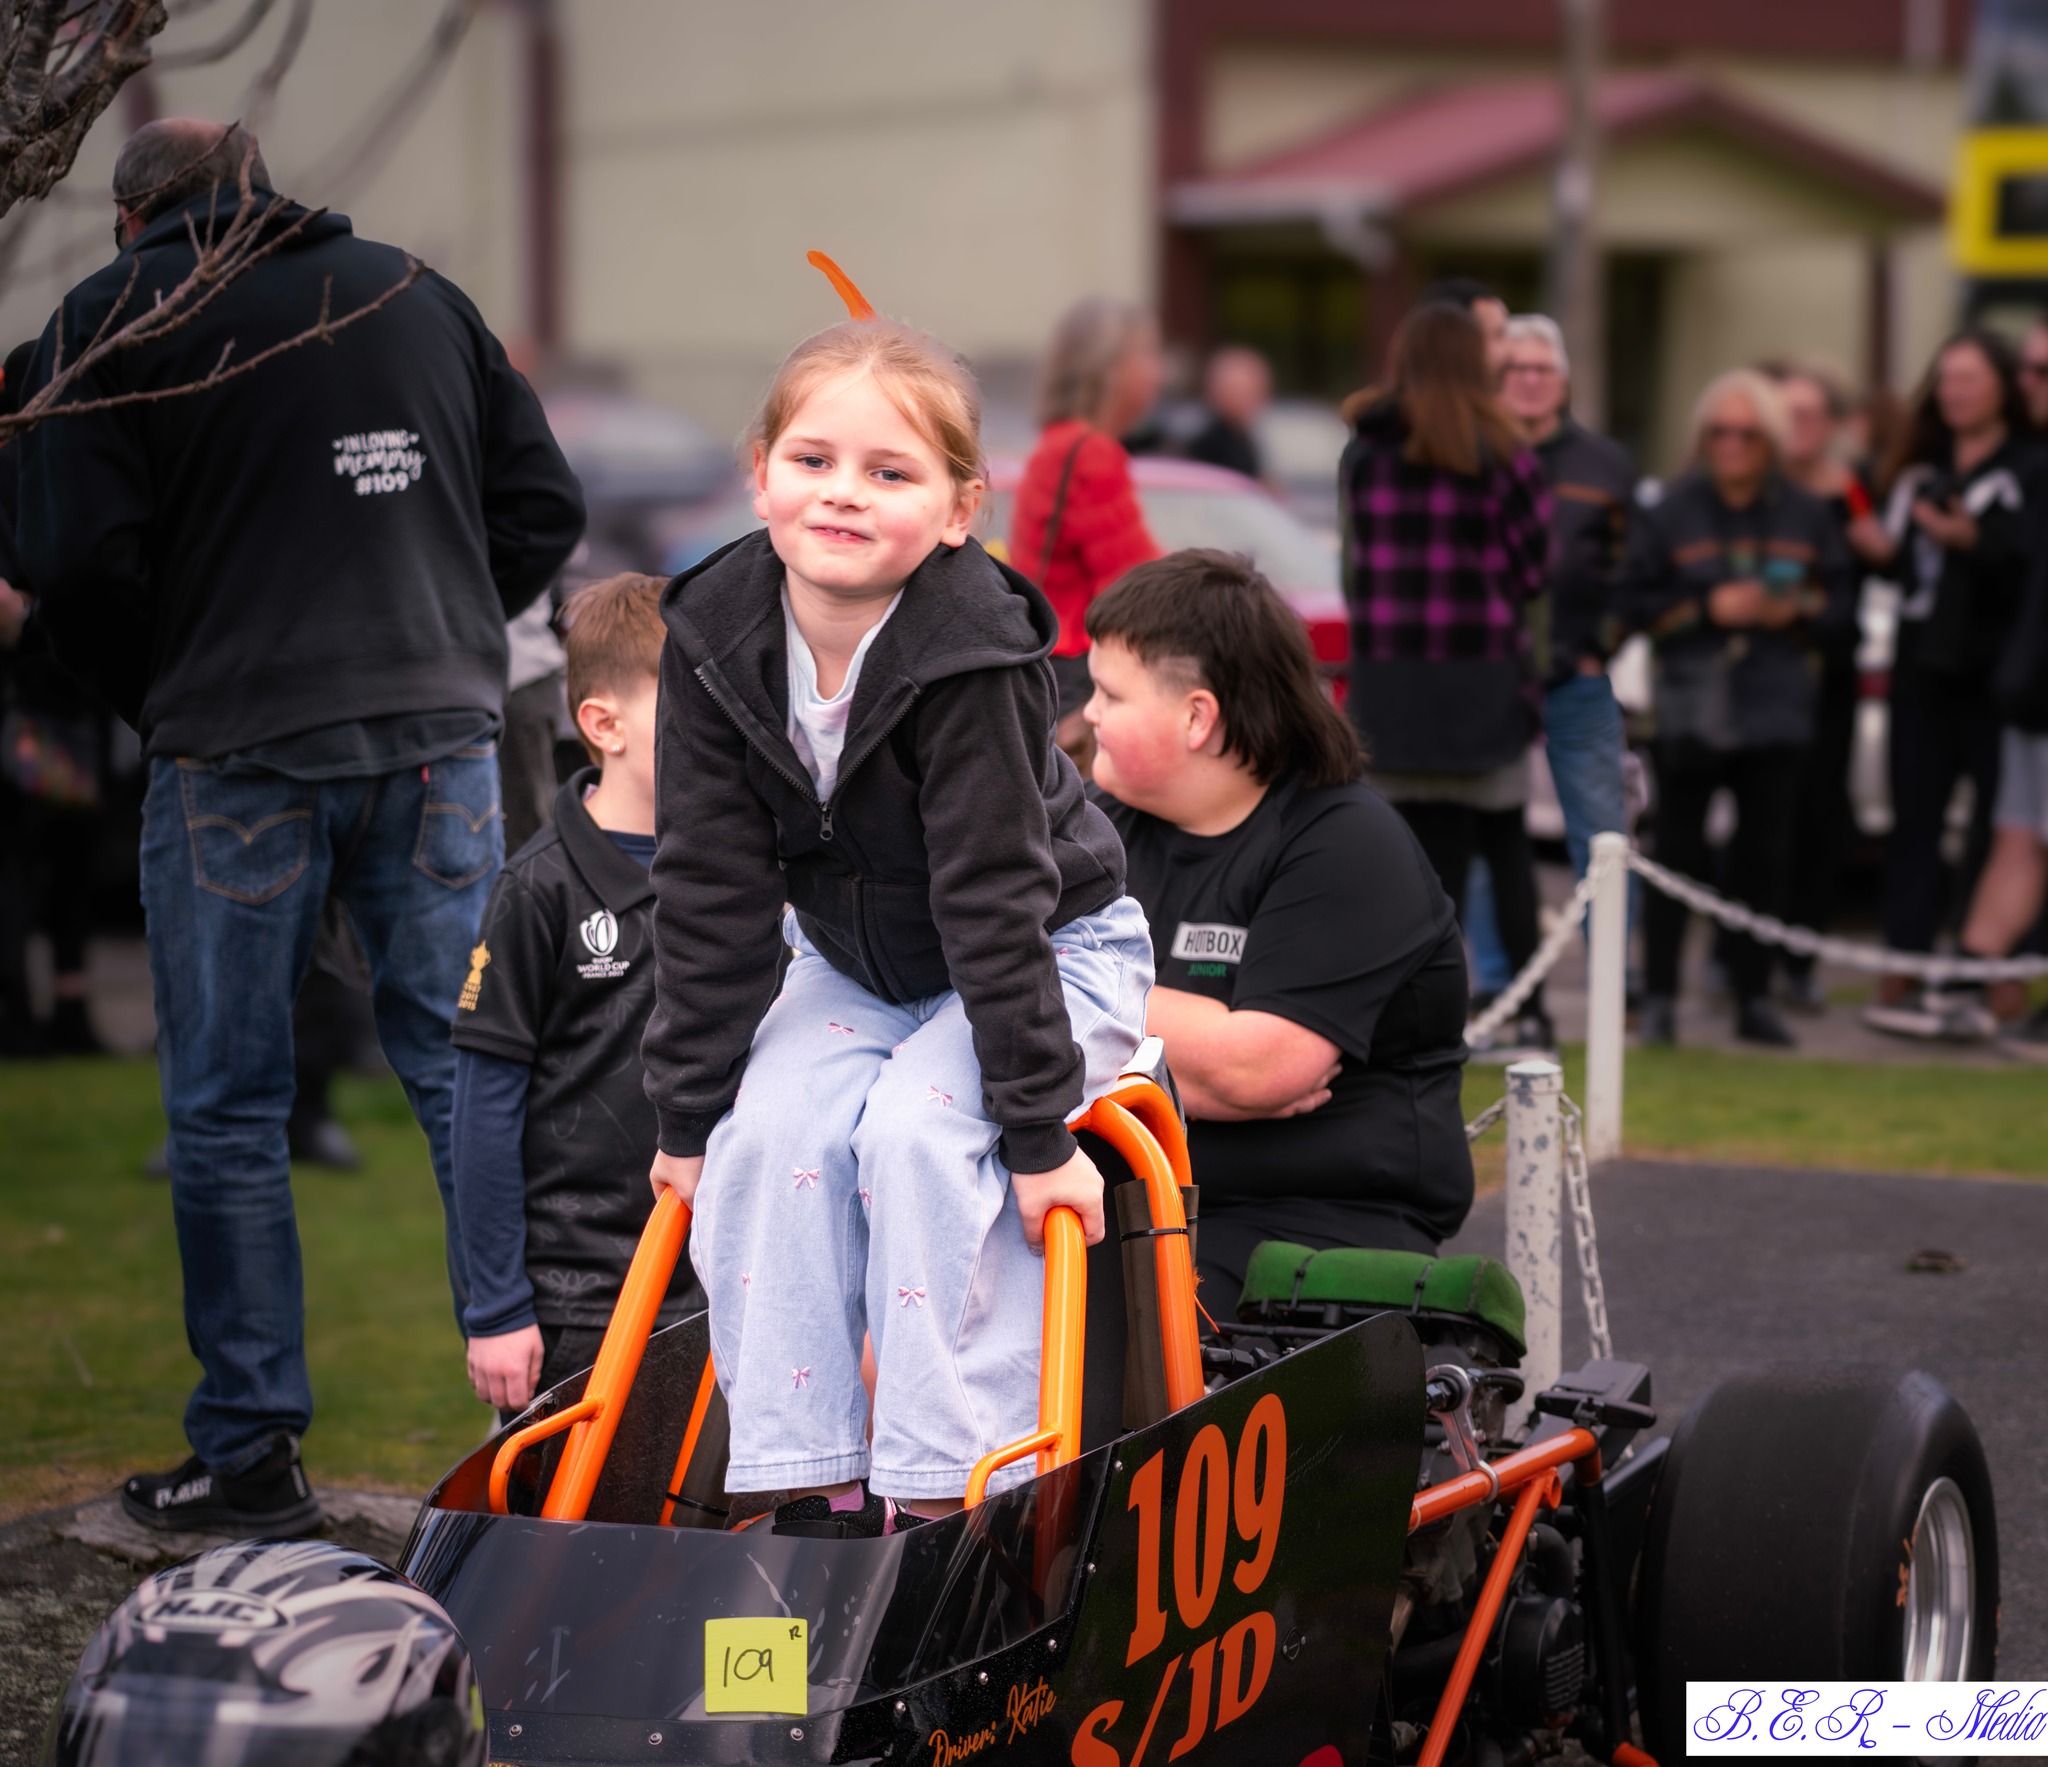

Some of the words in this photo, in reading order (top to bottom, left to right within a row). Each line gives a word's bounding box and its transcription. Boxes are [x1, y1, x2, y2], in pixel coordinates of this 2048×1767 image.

[361, 430, 409, 451] LOVING
[355, 470, 409, 496] #109
[577, 963, 610, 973] WORLD
[611, 961, 630, 971] CUP
[1187, 963, 1227, 977] JUNIOR
[1125, 1393, 1287, 1668] 109
[723, 1646, 774, 1688] 109
[1006, 1675, 1057, 1745] Katie
